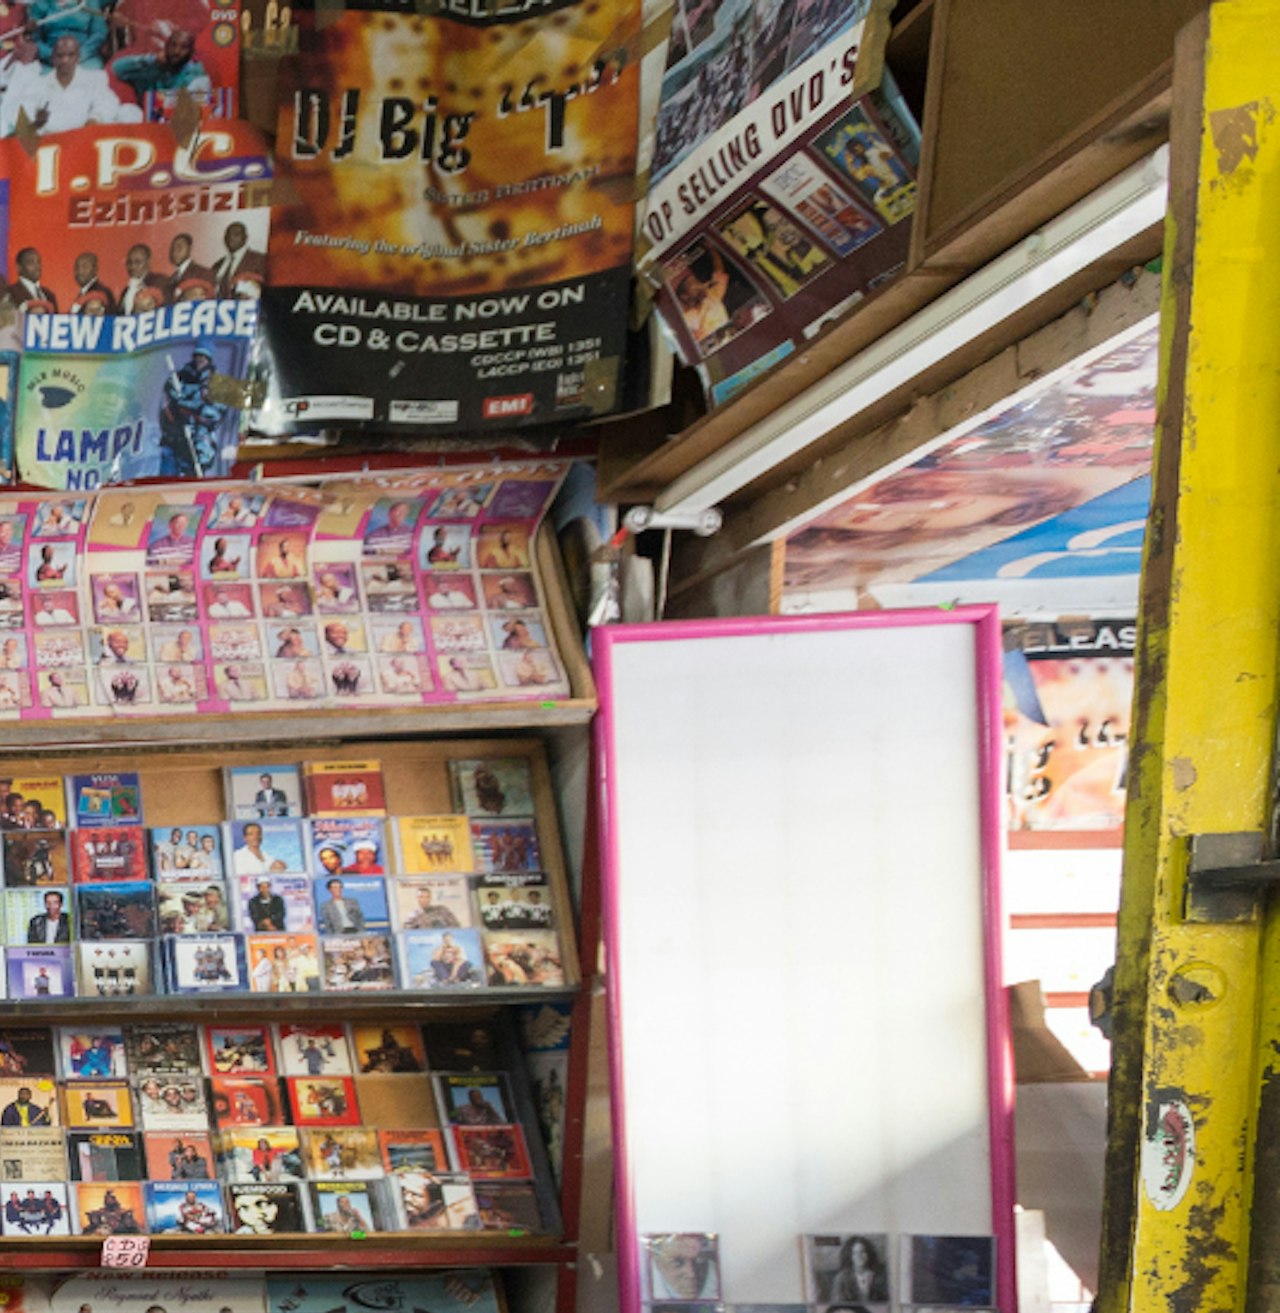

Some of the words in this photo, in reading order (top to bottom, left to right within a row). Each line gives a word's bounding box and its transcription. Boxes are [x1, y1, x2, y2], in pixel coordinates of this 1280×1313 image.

[380, 95, 475, 176] Big
[677, 121, 760, 216] SELLING
[293, 229, 370, 254] Featuring
[373, 240, 397, 255] the
[469, 234, 518, 256] Sister
[292, 290, 447, 321] AVAILABLE
[454, 293, 529, 321] NOW
[537, 284, 585, 309] ON
[26, 313, 104, 350] NEW
[112, 300, 256, 351] RELEASE
[314, 323, 361, 347] CD
[366, 328, 389, 349] &
[396, 321, 556, 353] CASSETTE
[486, 397, 528, 416] EMI
